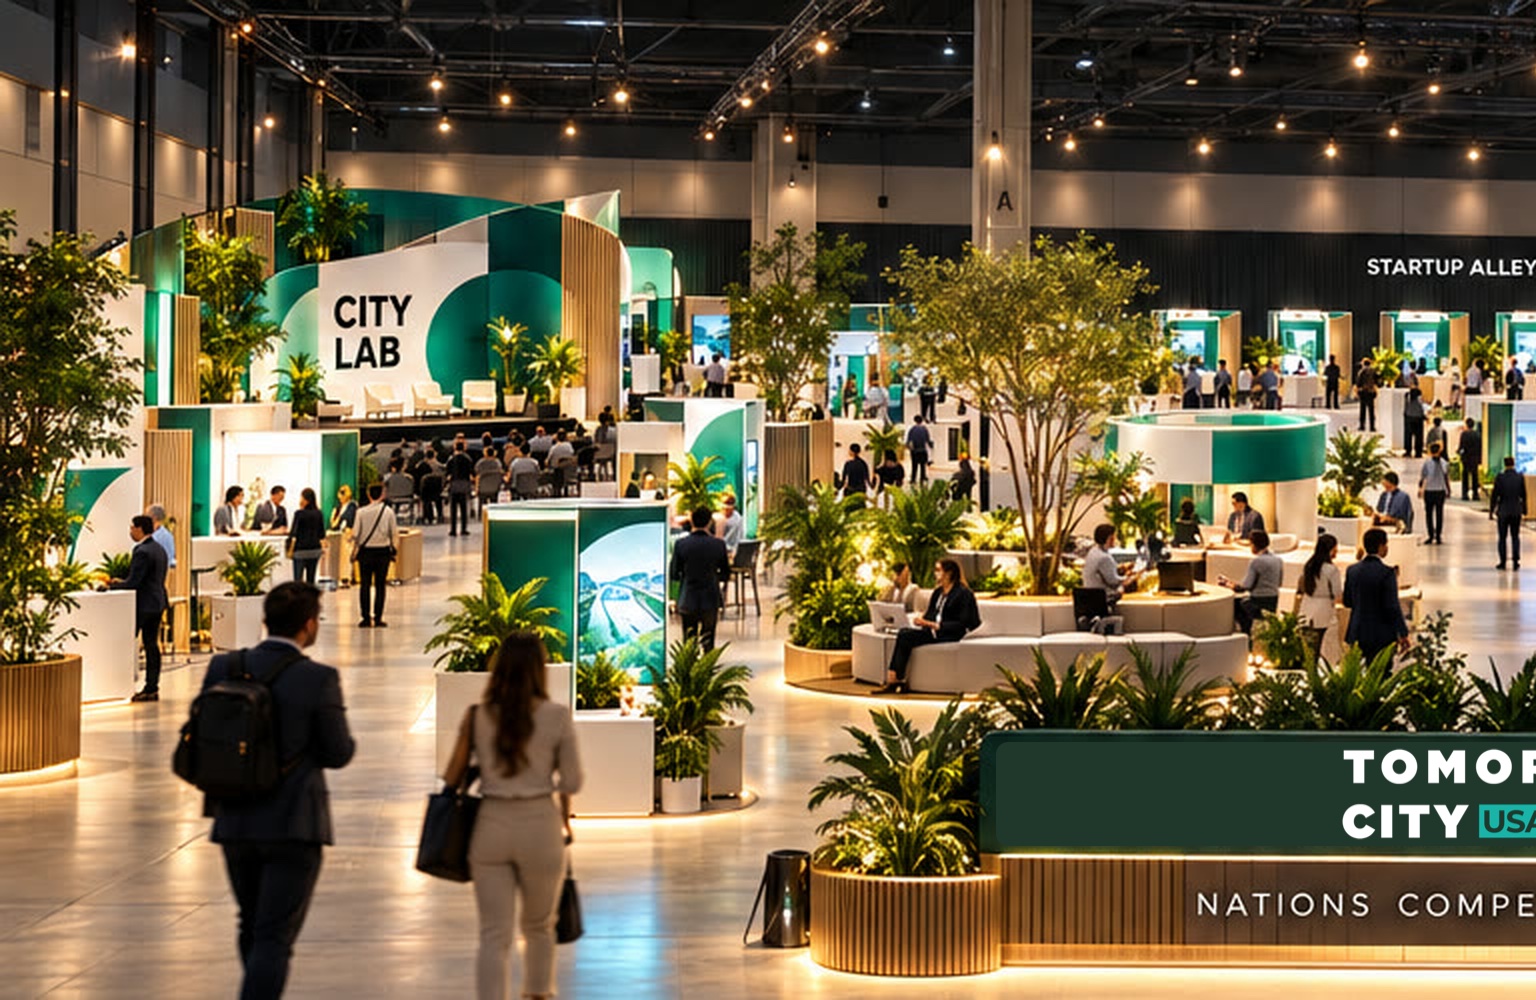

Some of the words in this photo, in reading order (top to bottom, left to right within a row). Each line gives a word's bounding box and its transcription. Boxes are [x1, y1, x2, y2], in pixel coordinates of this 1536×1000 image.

[997, 190, 1013, 211] A
[1367, 258, 1464, 276] STARTUP
[333, 294, 412, 329] CITY
[335, 336, 401, 370] LAB
[1342, 803, 1469, 840] CITY
[1197, 892, 1371, 918] NATIONS
